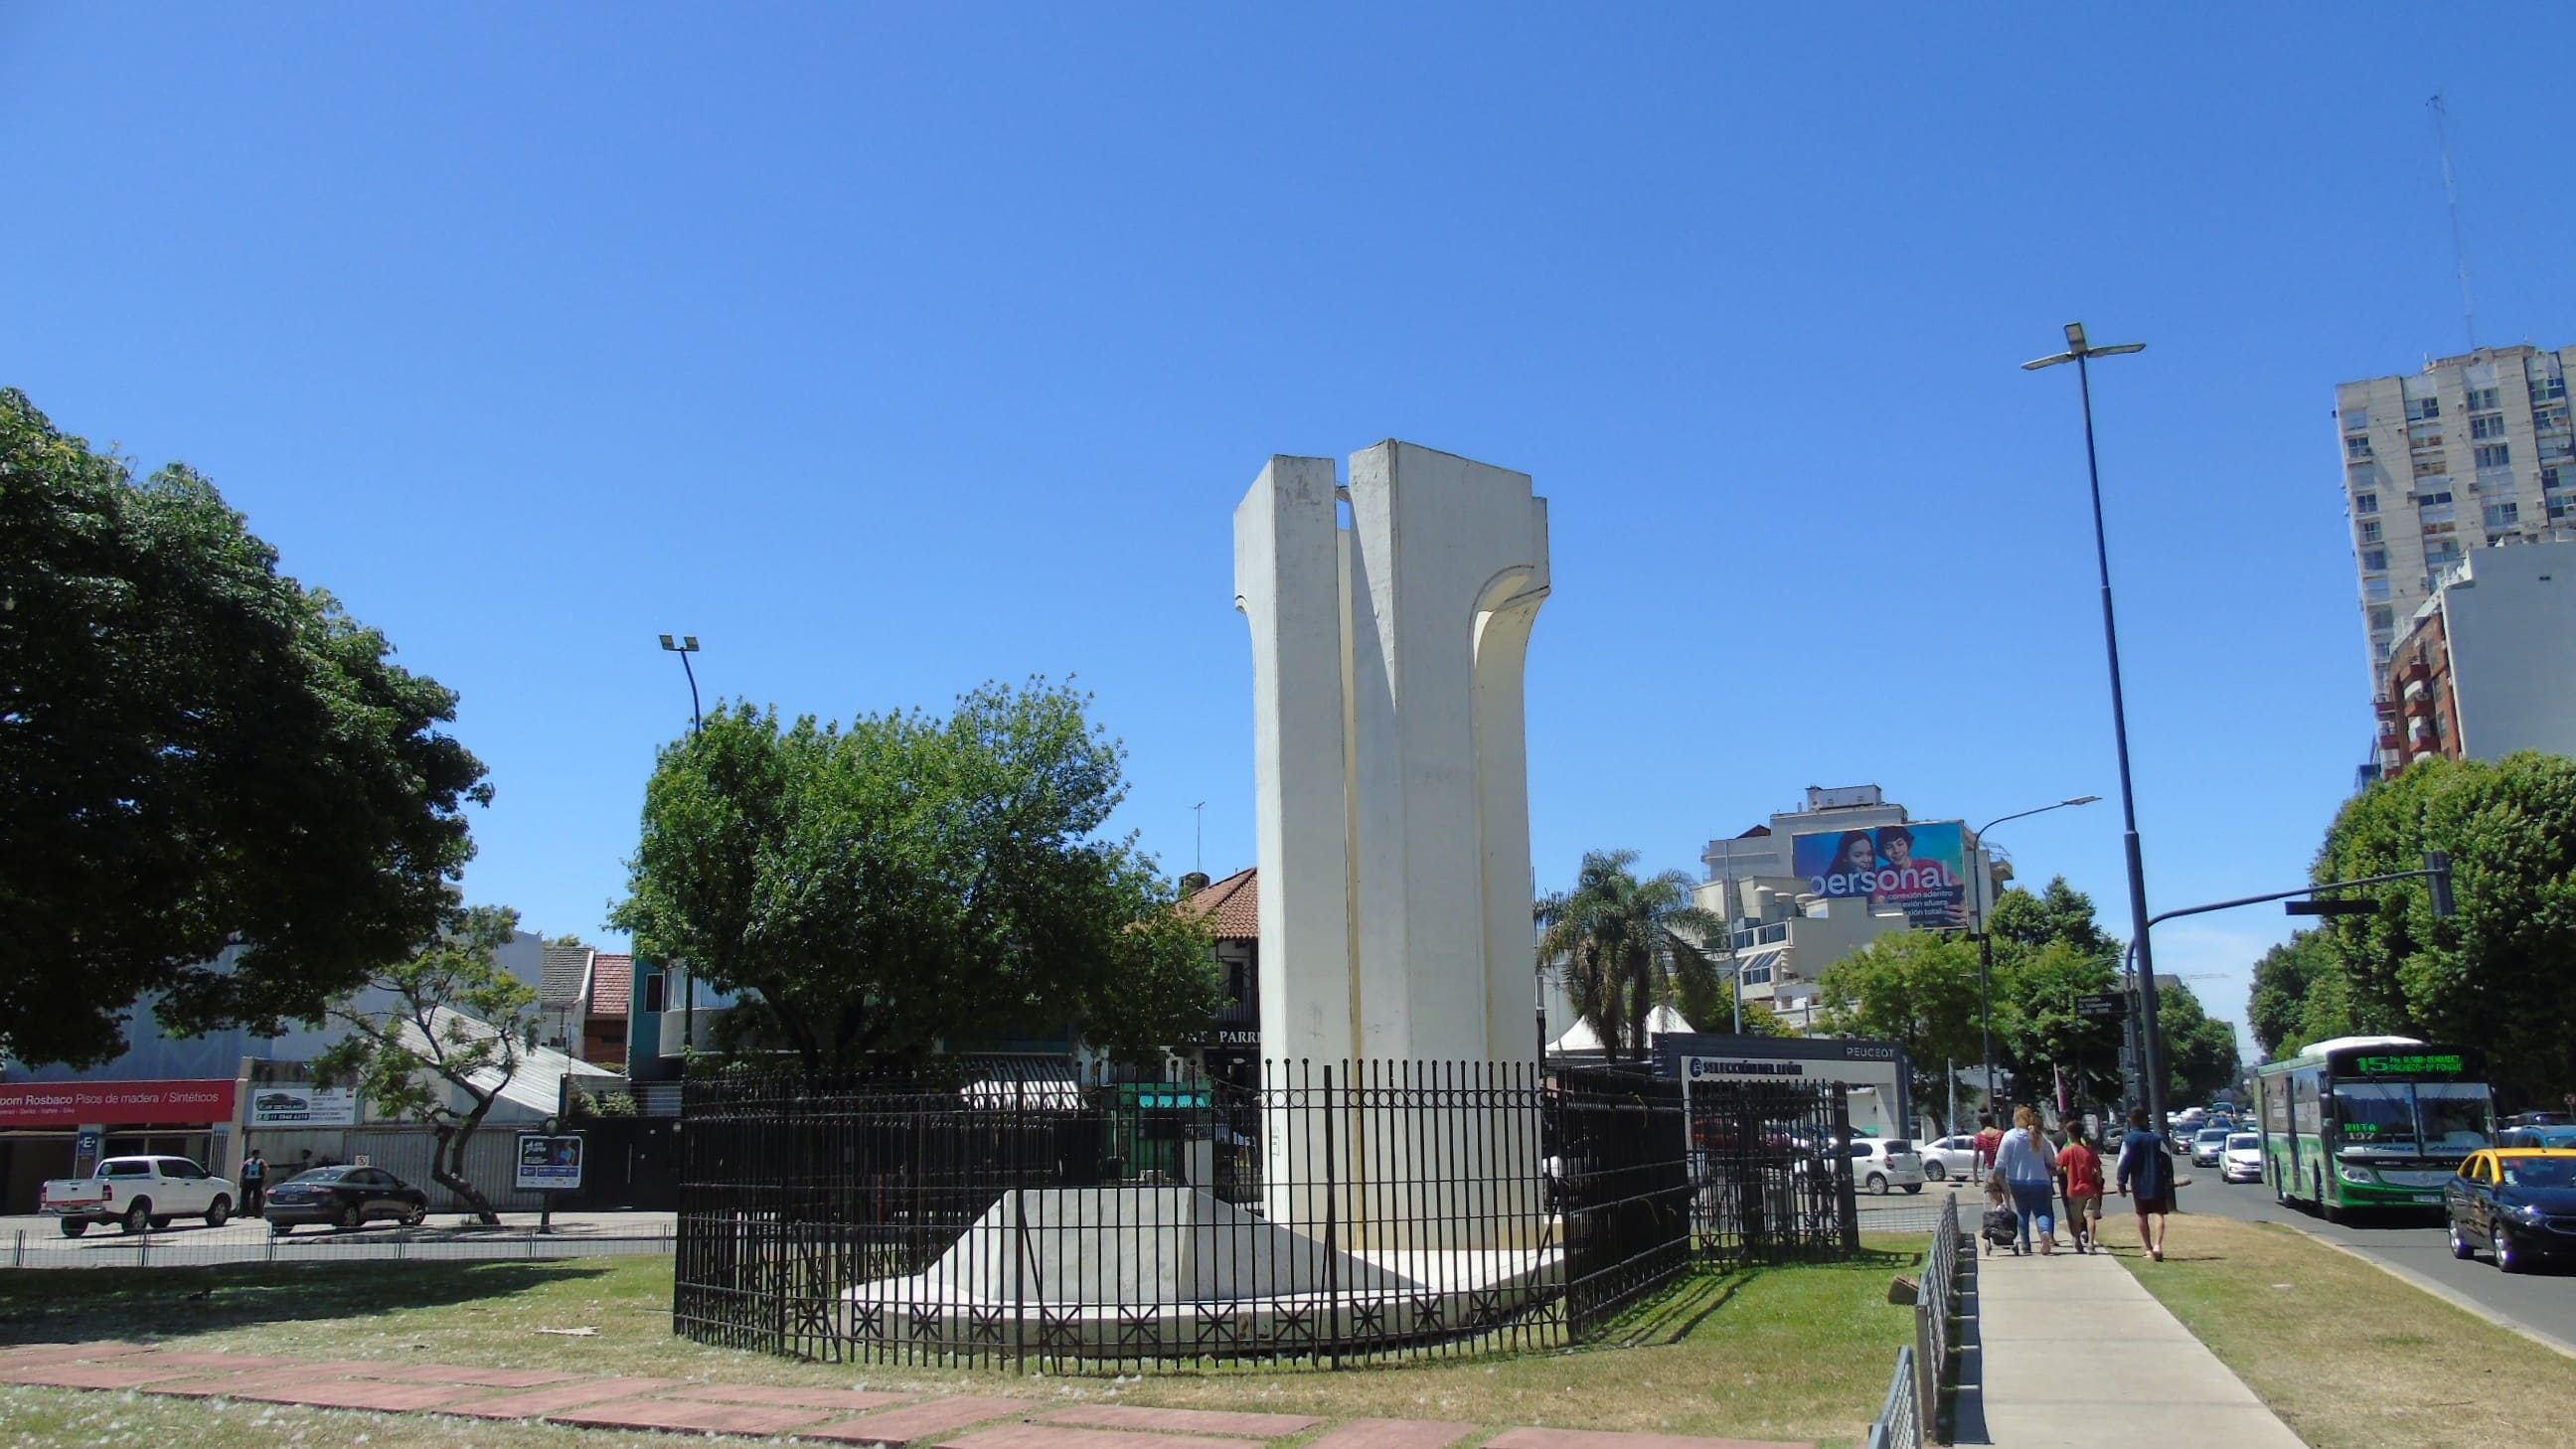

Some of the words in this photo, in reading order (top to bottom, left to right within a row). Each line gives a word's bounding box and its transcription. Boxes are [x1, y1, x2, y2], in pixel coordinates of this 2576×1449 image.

[1923, 889, 1954, 898] adentro
[1847, 1047, 1894, 1057] PEUGEOT
[1703, 1059, 1757, 1073] SELECCIÓN
[2356, 1056, 2388, 1071] 15
[25, 1094, 73, 1105] Rosbaco
[76, 1093, 101, 1104] Pisos
[105, 1092, 118, 1103] de
[121, 1092, 159, 1103] madera
[169, 1091, 219, 1102] Sintéticos
[82, 1136, 92, 1148] E
